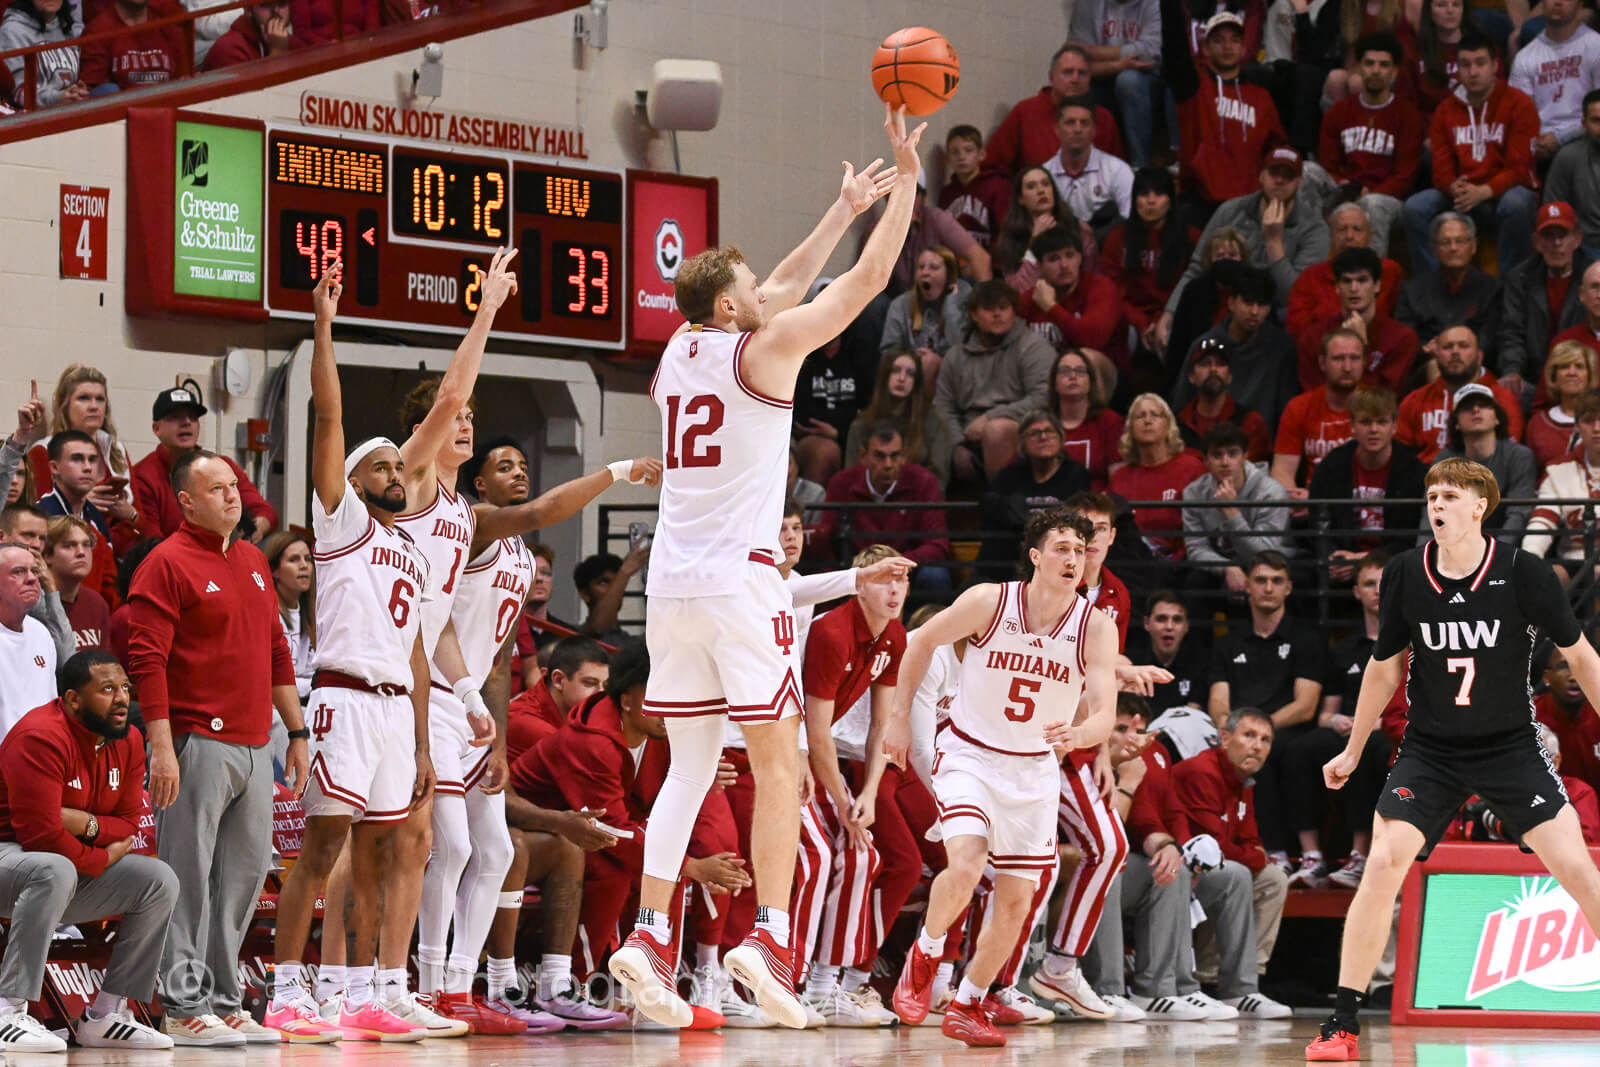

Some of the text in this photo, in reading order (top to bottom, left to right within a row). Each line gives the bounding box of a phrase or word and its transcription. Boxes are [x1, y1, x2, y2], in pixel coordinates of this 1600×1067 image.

[305, 95, 588, 159] SIMON SKJODT ASSEMBLY HALL
[277, 142, 383, 193] INDIANA
[64, 194, 105, 218] SECTION
[181, 191, 239, 223] Greene
[413, 164, 505, 238] 10:12
[546, 176, 591, 217] UIW
[75, 219, 92, 268] 4
[181, 221, 256, 254] &Schultz
[296, 220, 342, 286] 48
[190, 266, 256, 283] TRIAL LAWYERS
[408, 264, 481, 312] PERIOD 2
[569, 248, 608, 315] 33
[638, 289, 679, 313] Country
[666, 394, 725, 469] 12
[431, 518, 470, 546] INDIA
[442, 547, 462, 595] 1
[492, 570, 527, 601] INDIA
[388, 578, 415, 628] 6
[495, 597, 520, 643] 0
[1006, 620, 1018, 633] 76
[1419, 619, 1501, 650] UIW
[986, 650, 1070, 684] INDIANA
[1447, 657, 1477, 706] 7
[1004, 677, 1042, 723] 5
[273, 814, 306, 831] merica
[46, 963, 107, 1003] HyVe
